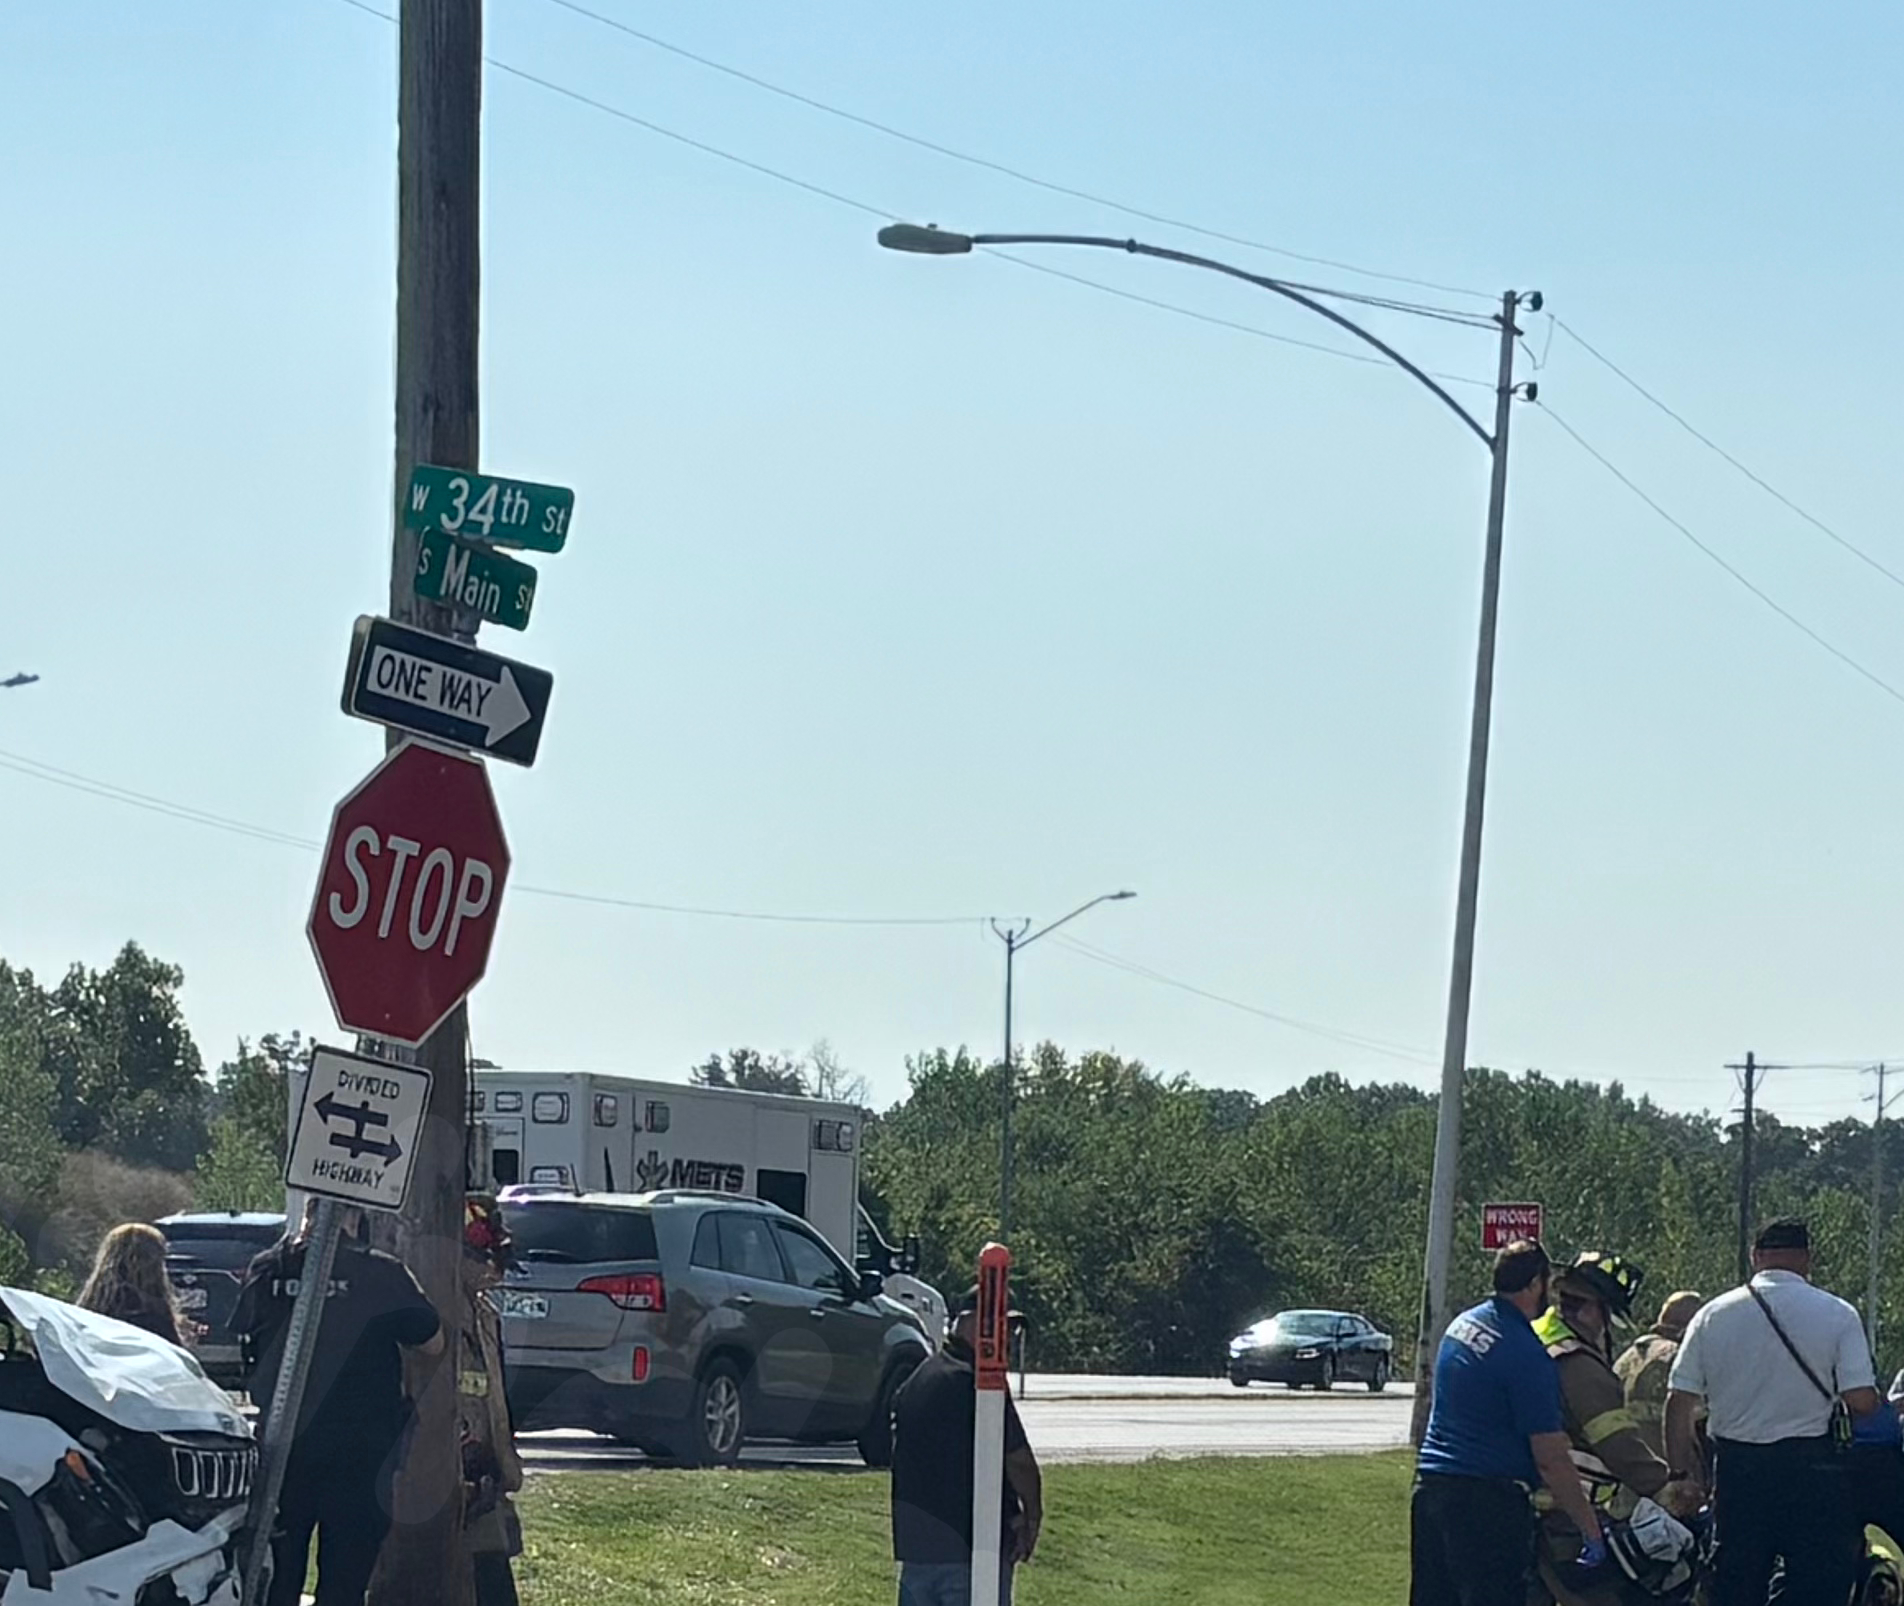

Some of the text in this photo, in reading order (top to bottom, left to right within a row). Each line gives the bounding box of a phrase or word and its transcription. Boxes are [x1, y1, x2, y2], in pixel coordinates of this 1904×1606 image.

[411, 477, 566, 536] W 34th St
[418, 548, 432, 575] S
[439, 543, 501, 614] Main
[376, 653, 492, 717] ONE WAY
[329, 825, 493, 957] STOP
[337, 1070, 401, 1099] DIVIDED
[312, 1157, 384, 1189] HIGHWAY
[670, 1158, 745, 1193] METS
[1486, 1208, 1537, 1225] WRONG
